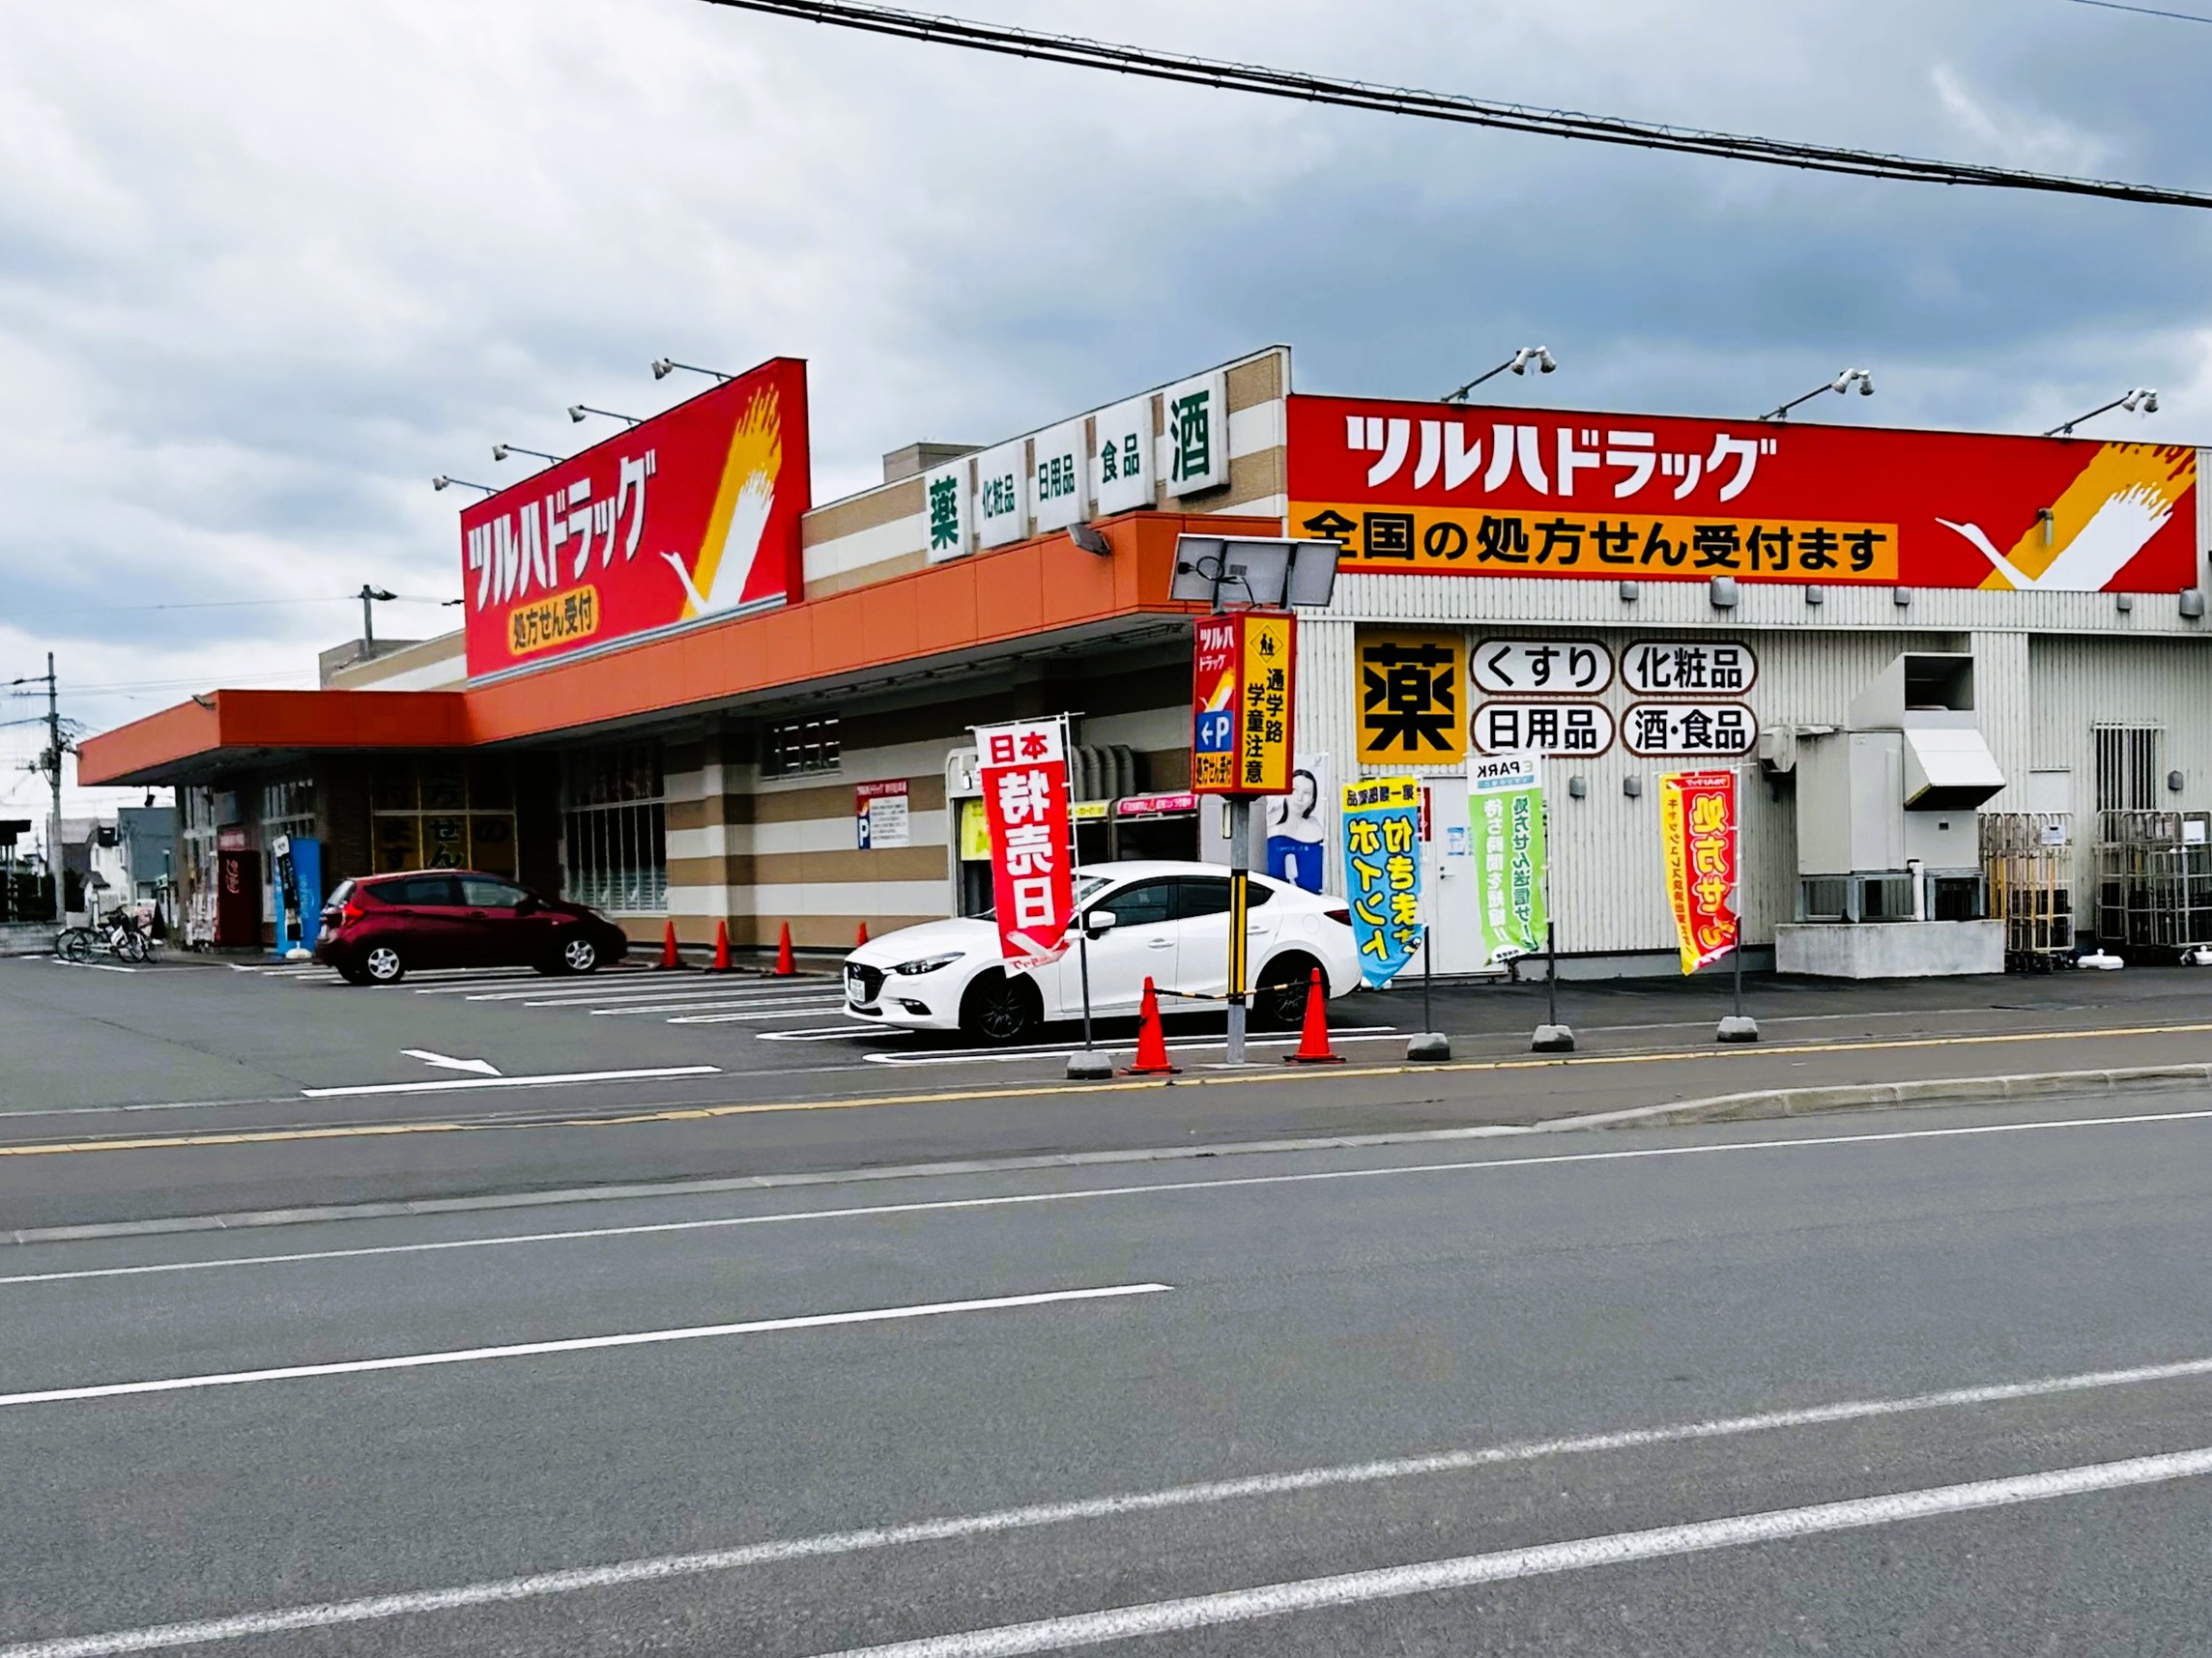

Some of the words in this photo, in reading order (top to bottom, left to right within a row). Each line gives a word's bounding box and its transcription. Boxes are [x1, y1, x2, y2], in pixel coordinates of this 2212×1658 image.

[1101, 433, 1139, 483] 食品
[1170, 389, 1210, 482] 酒
[1346, 415, 1776, 502] ツルハドラッグ
[982, 472, 1015, 520] 化粧品
[1039, 453, 1075, 501] 日用品
[468, 448, 656, 612] ツルハドラッグ
[930, 474, 959, 550] 薬
[1303, 508, 1887, 572] 全国の処方せん受付ます
[513, 588, 593, 649] 処方せん受付
[1199, 625, 1234, 651] ツルハ
[1199, 654, 1226, 672] ドラッグ
[1487, 645, 1597, 687] くすり
[1637, 645, 1741, 689] 化粧品
[1265, 668, 1284, 743] 通学路
[1363, 642, 1455, 751] 薬
[1216, 716, 1230, 748] P
[1245, 682, 1265, 784] 学童注意
[1489, 708, 1597, 750] 日用品
[859, 817, 869, 847] P
